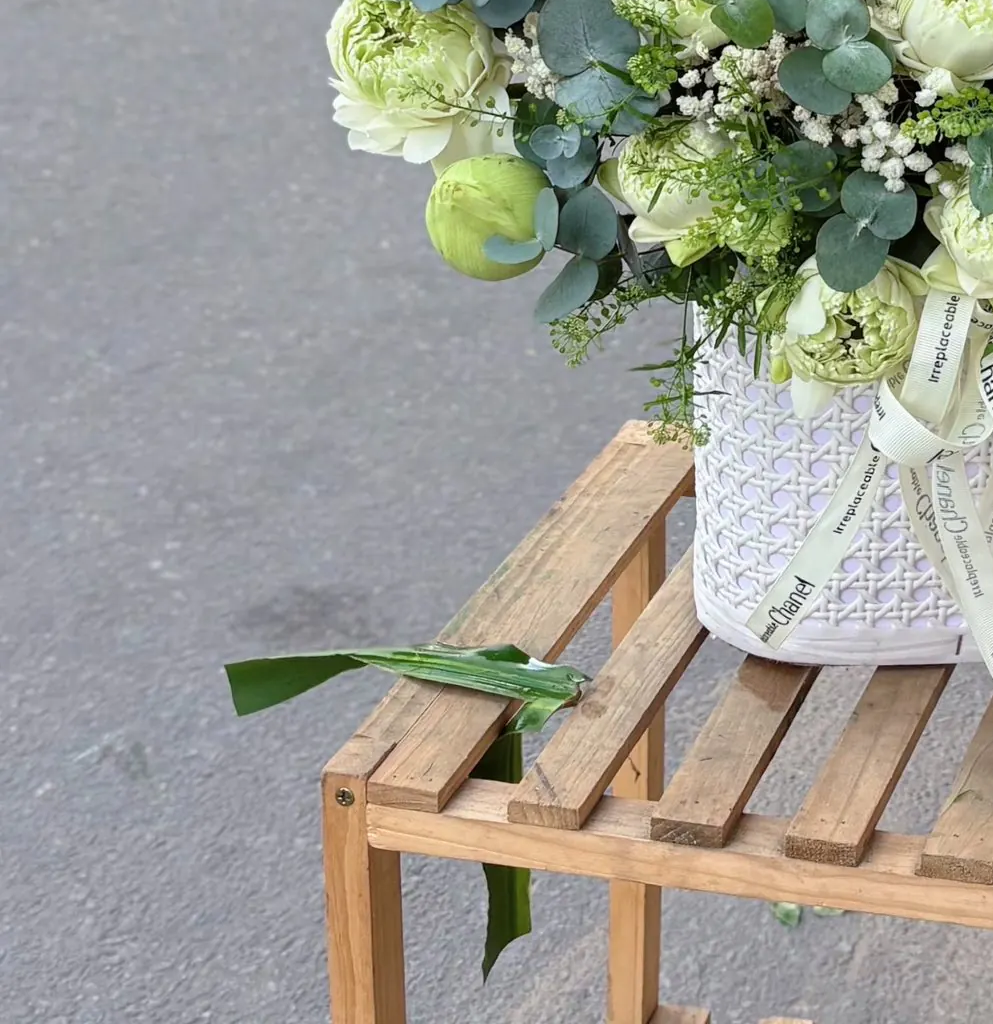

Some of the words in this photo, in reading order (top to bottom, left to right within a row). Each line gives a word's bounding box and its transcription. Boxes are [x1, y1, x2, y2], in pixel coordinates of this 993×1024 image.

[928, 295, 961, 383] Irreplaceable
[833, 454, 880, 534] Irreplaceable
[768, 575, 816, 626] Chanel
